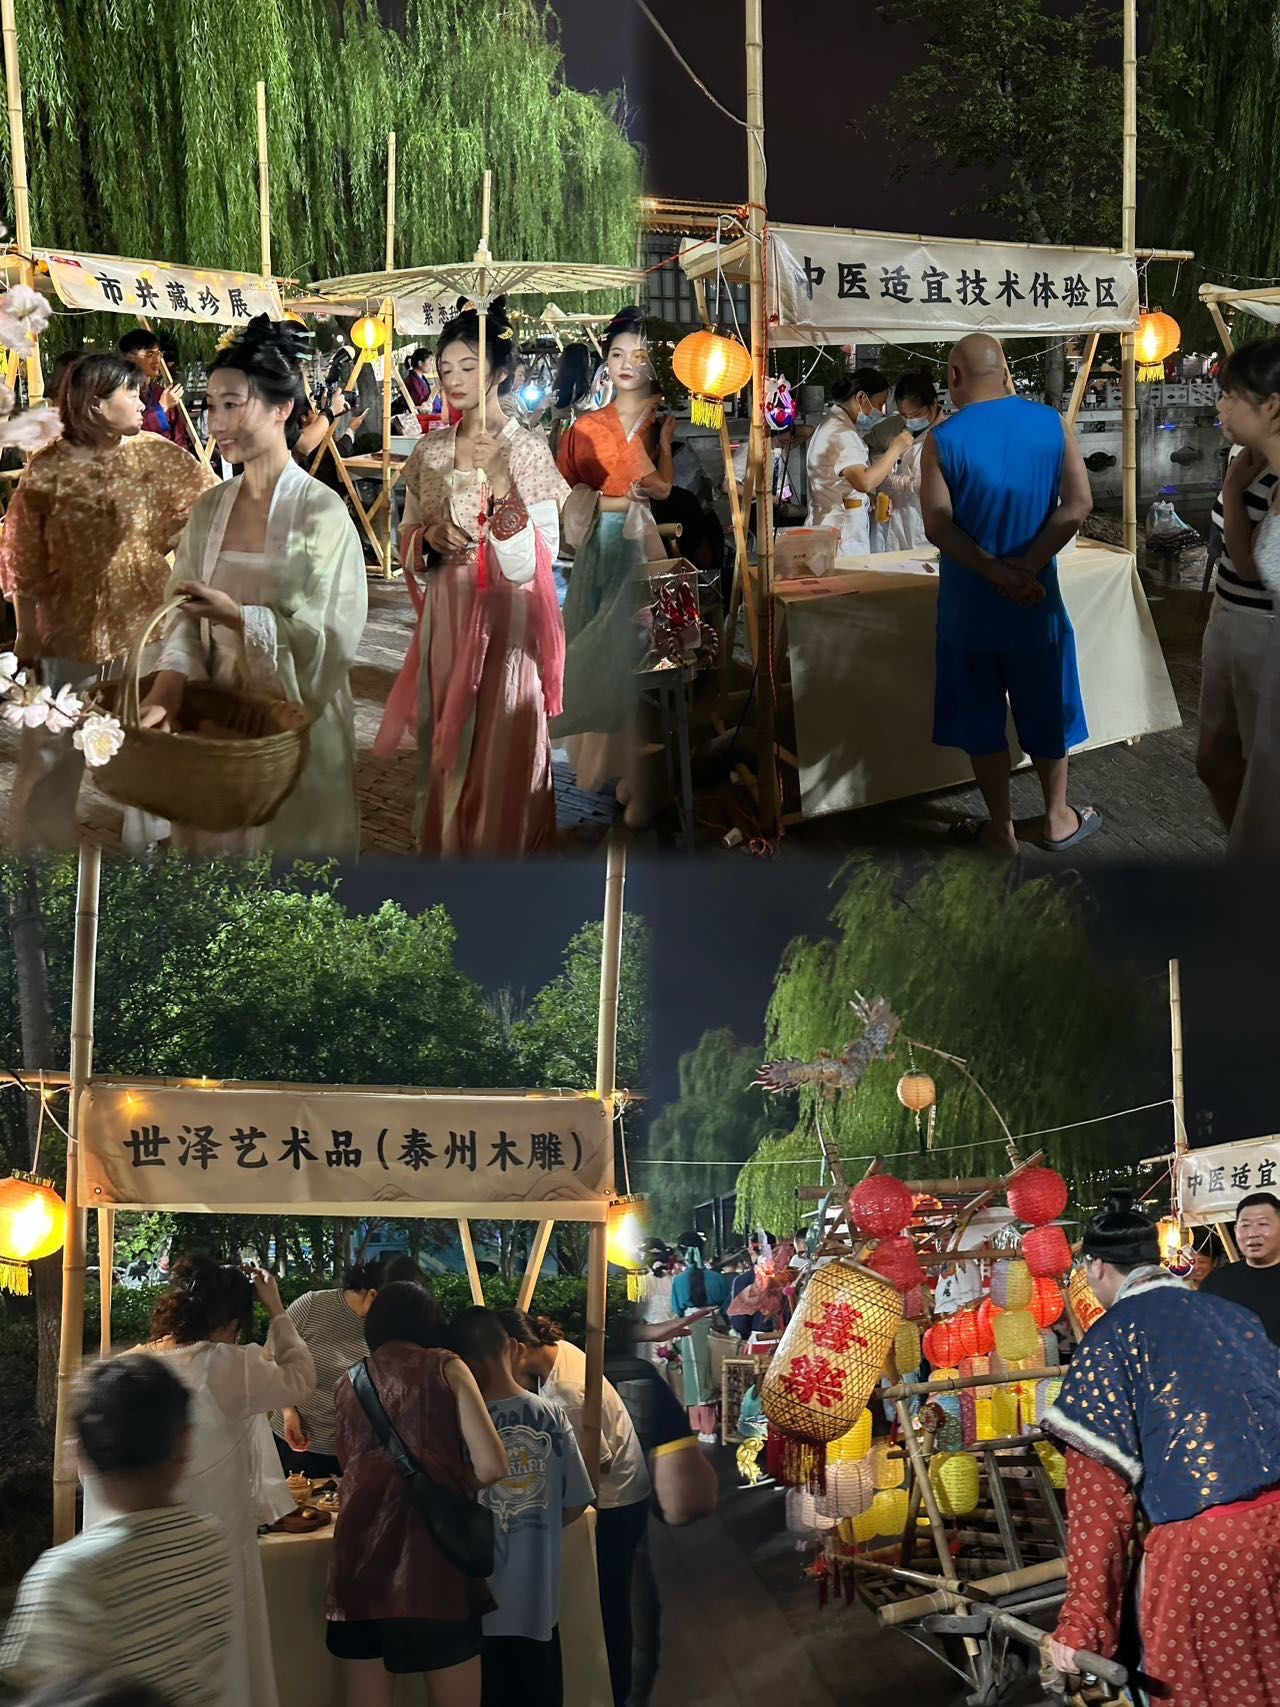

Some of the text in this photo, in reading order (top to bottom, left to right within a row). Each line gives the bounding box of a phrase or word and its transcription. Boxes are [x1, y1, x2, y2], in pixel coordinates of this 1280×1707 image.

[94, 271, 253, 318] 市井藏珍展
[799, 255, 1119, 309] 中医适宜技术体验区
[123, 1124, 583, 1172] 世泽艺术品（泰州木雕）
[1187, 1158, 1277, 1197] 中医适宜
